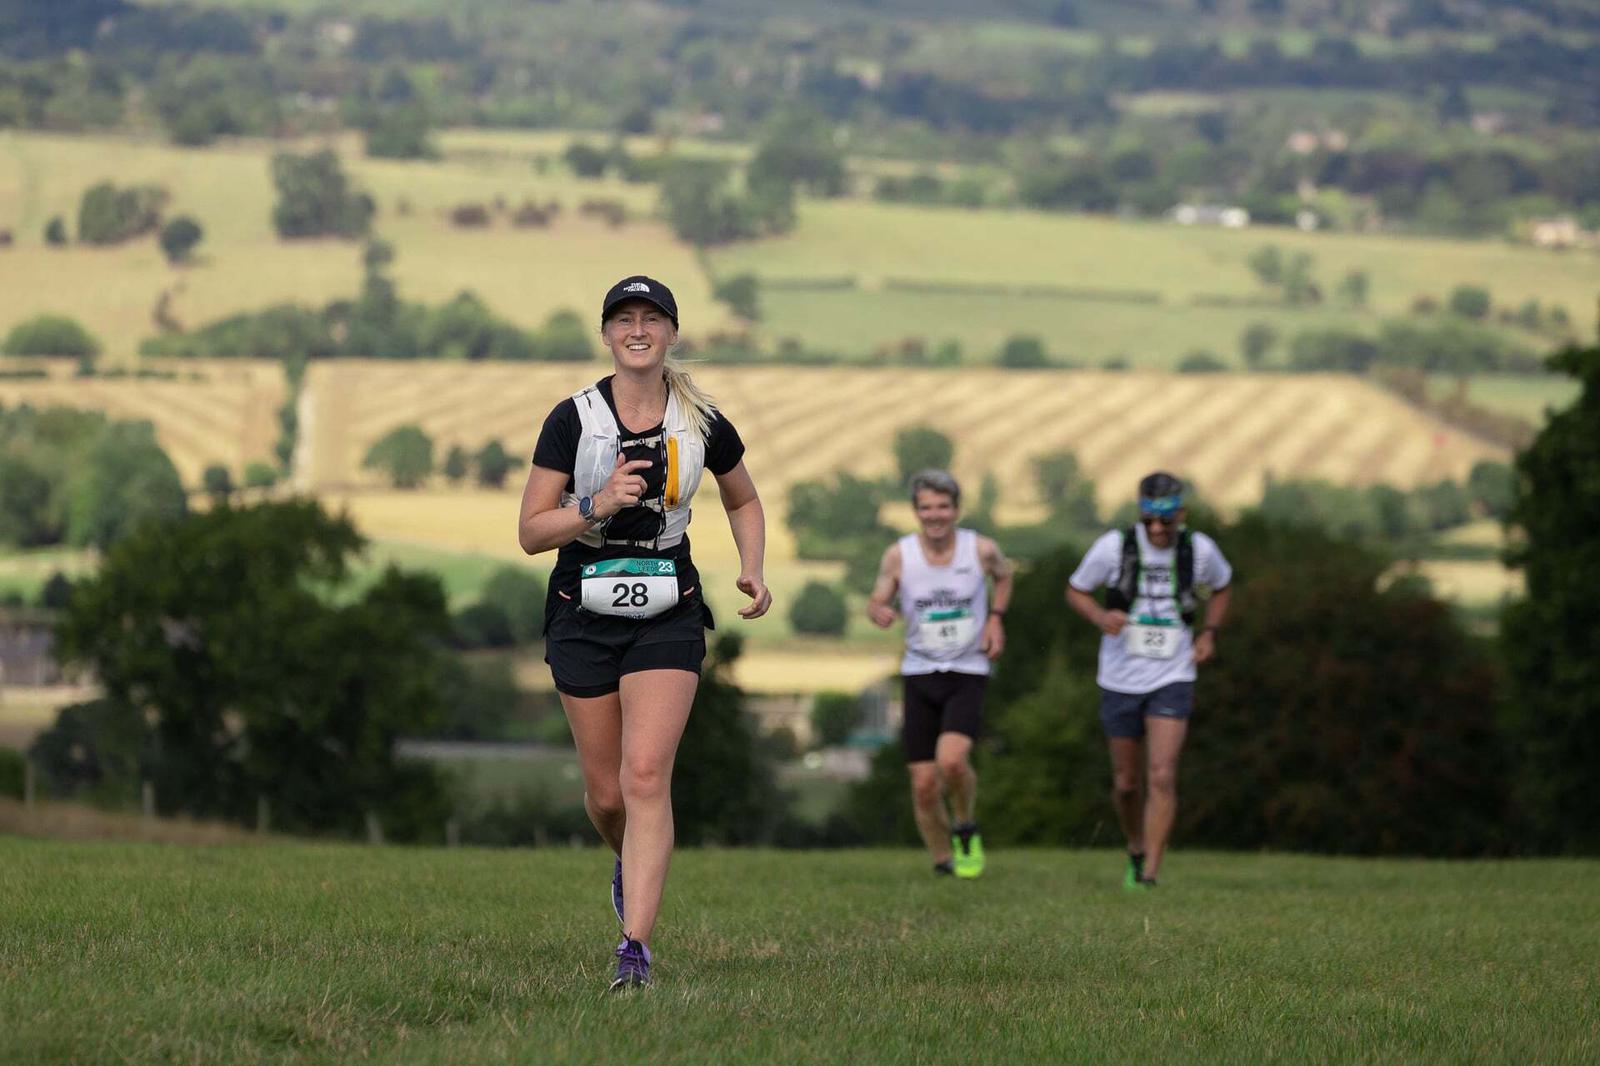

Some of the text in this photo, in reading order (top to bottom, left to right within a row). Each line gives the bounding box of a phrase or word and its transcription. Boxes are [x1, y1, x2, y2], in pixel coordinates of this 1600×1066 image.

[658, 561, 673, 572] 23
[612, 582, 649, 608] 28
[1143, 631, 1167, 647] 23
